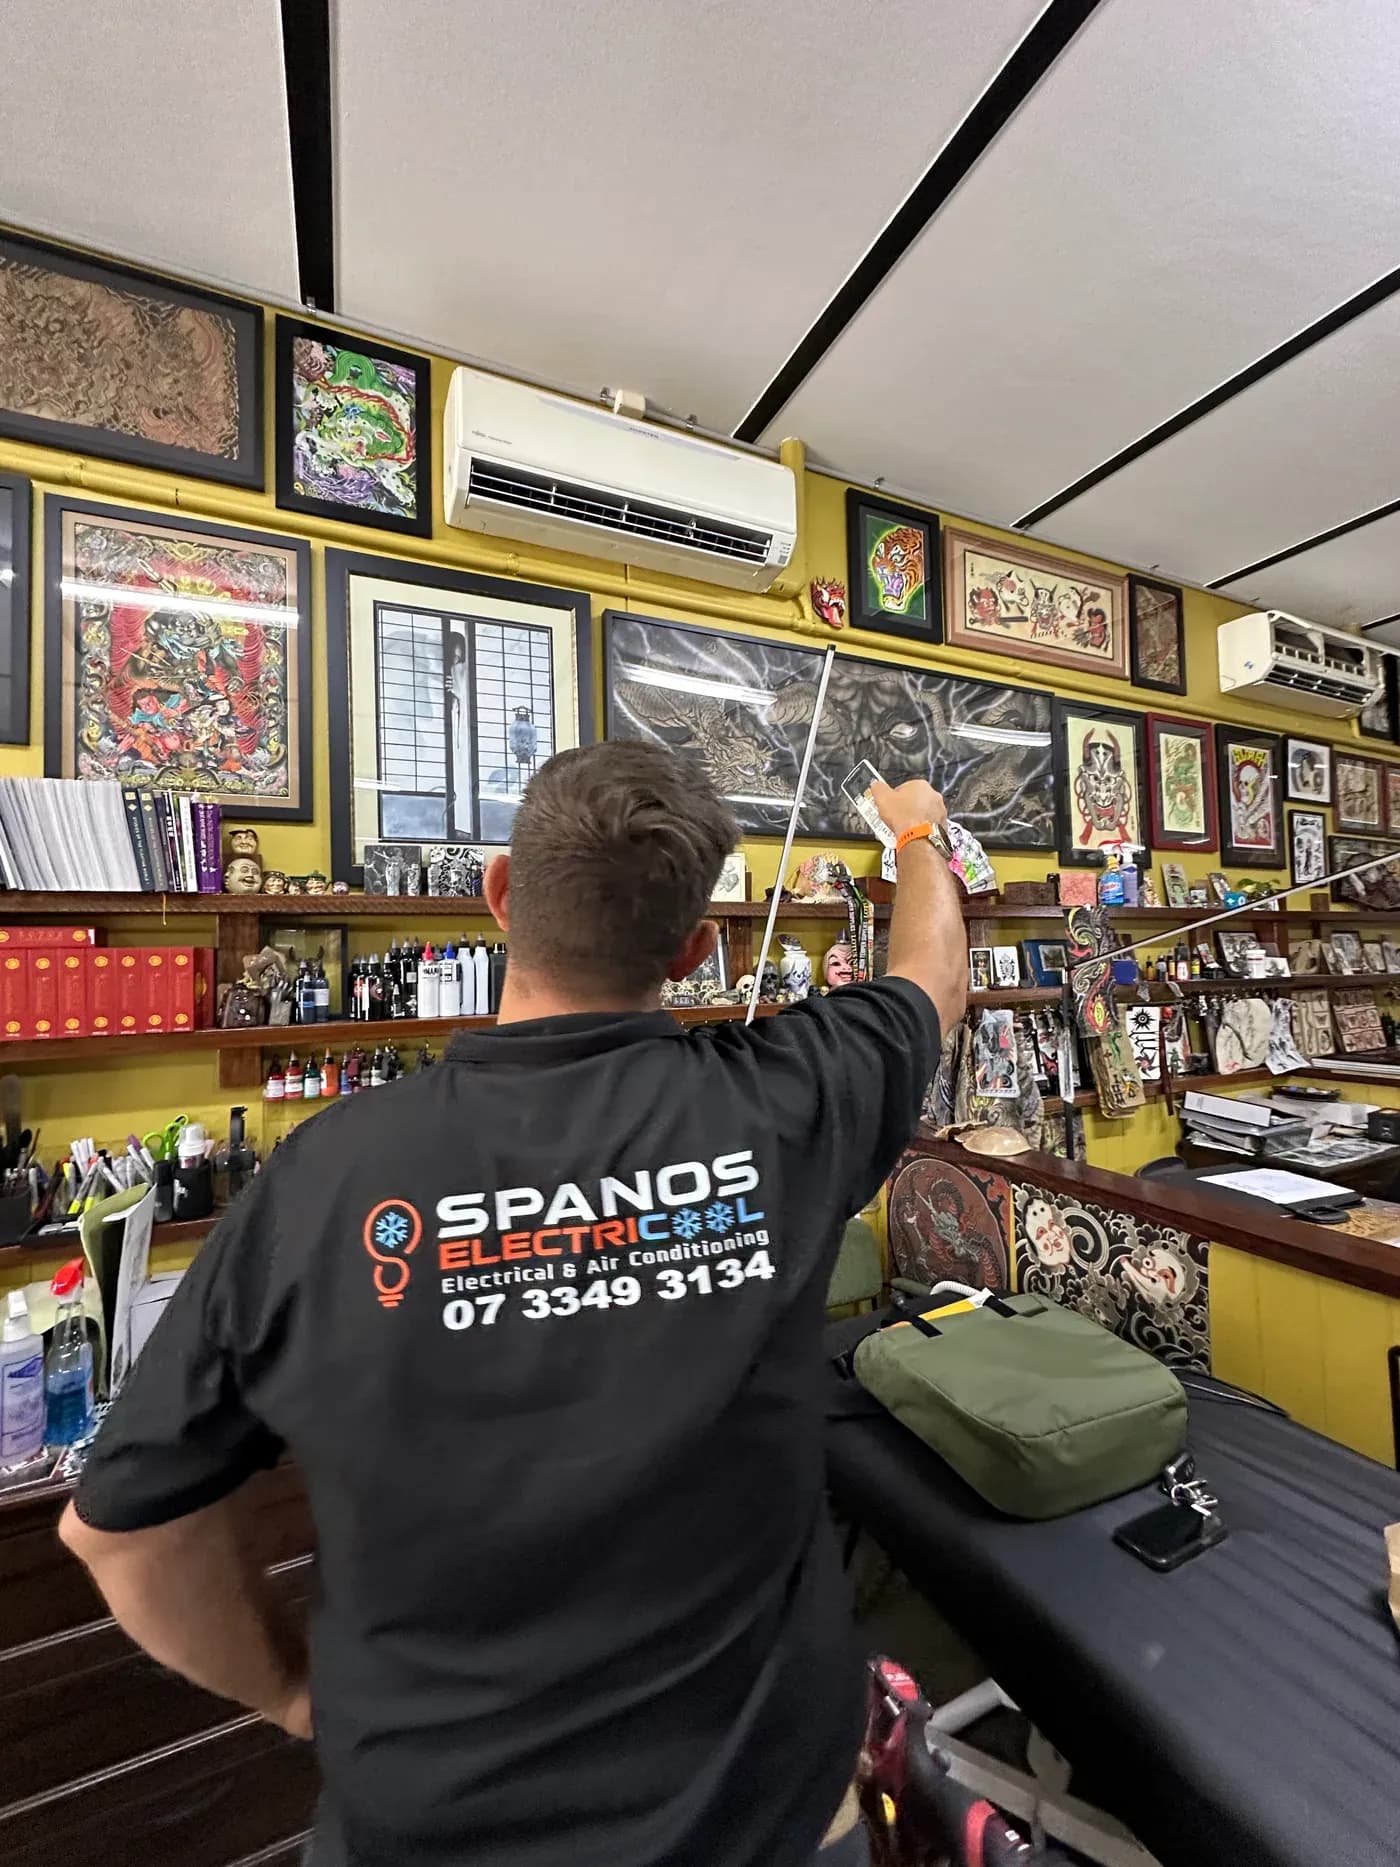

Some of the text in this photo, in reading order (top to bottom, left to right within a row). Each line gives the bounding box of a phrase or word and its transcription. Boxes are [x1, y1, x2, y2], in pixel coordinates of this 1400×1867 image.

[436, 1150, 760, 1239] SPANOS
[441, 1228, 770, 1294] Electrical & Air Conditioning
[442, 1250, 776, 1331] 07 3349 3134
